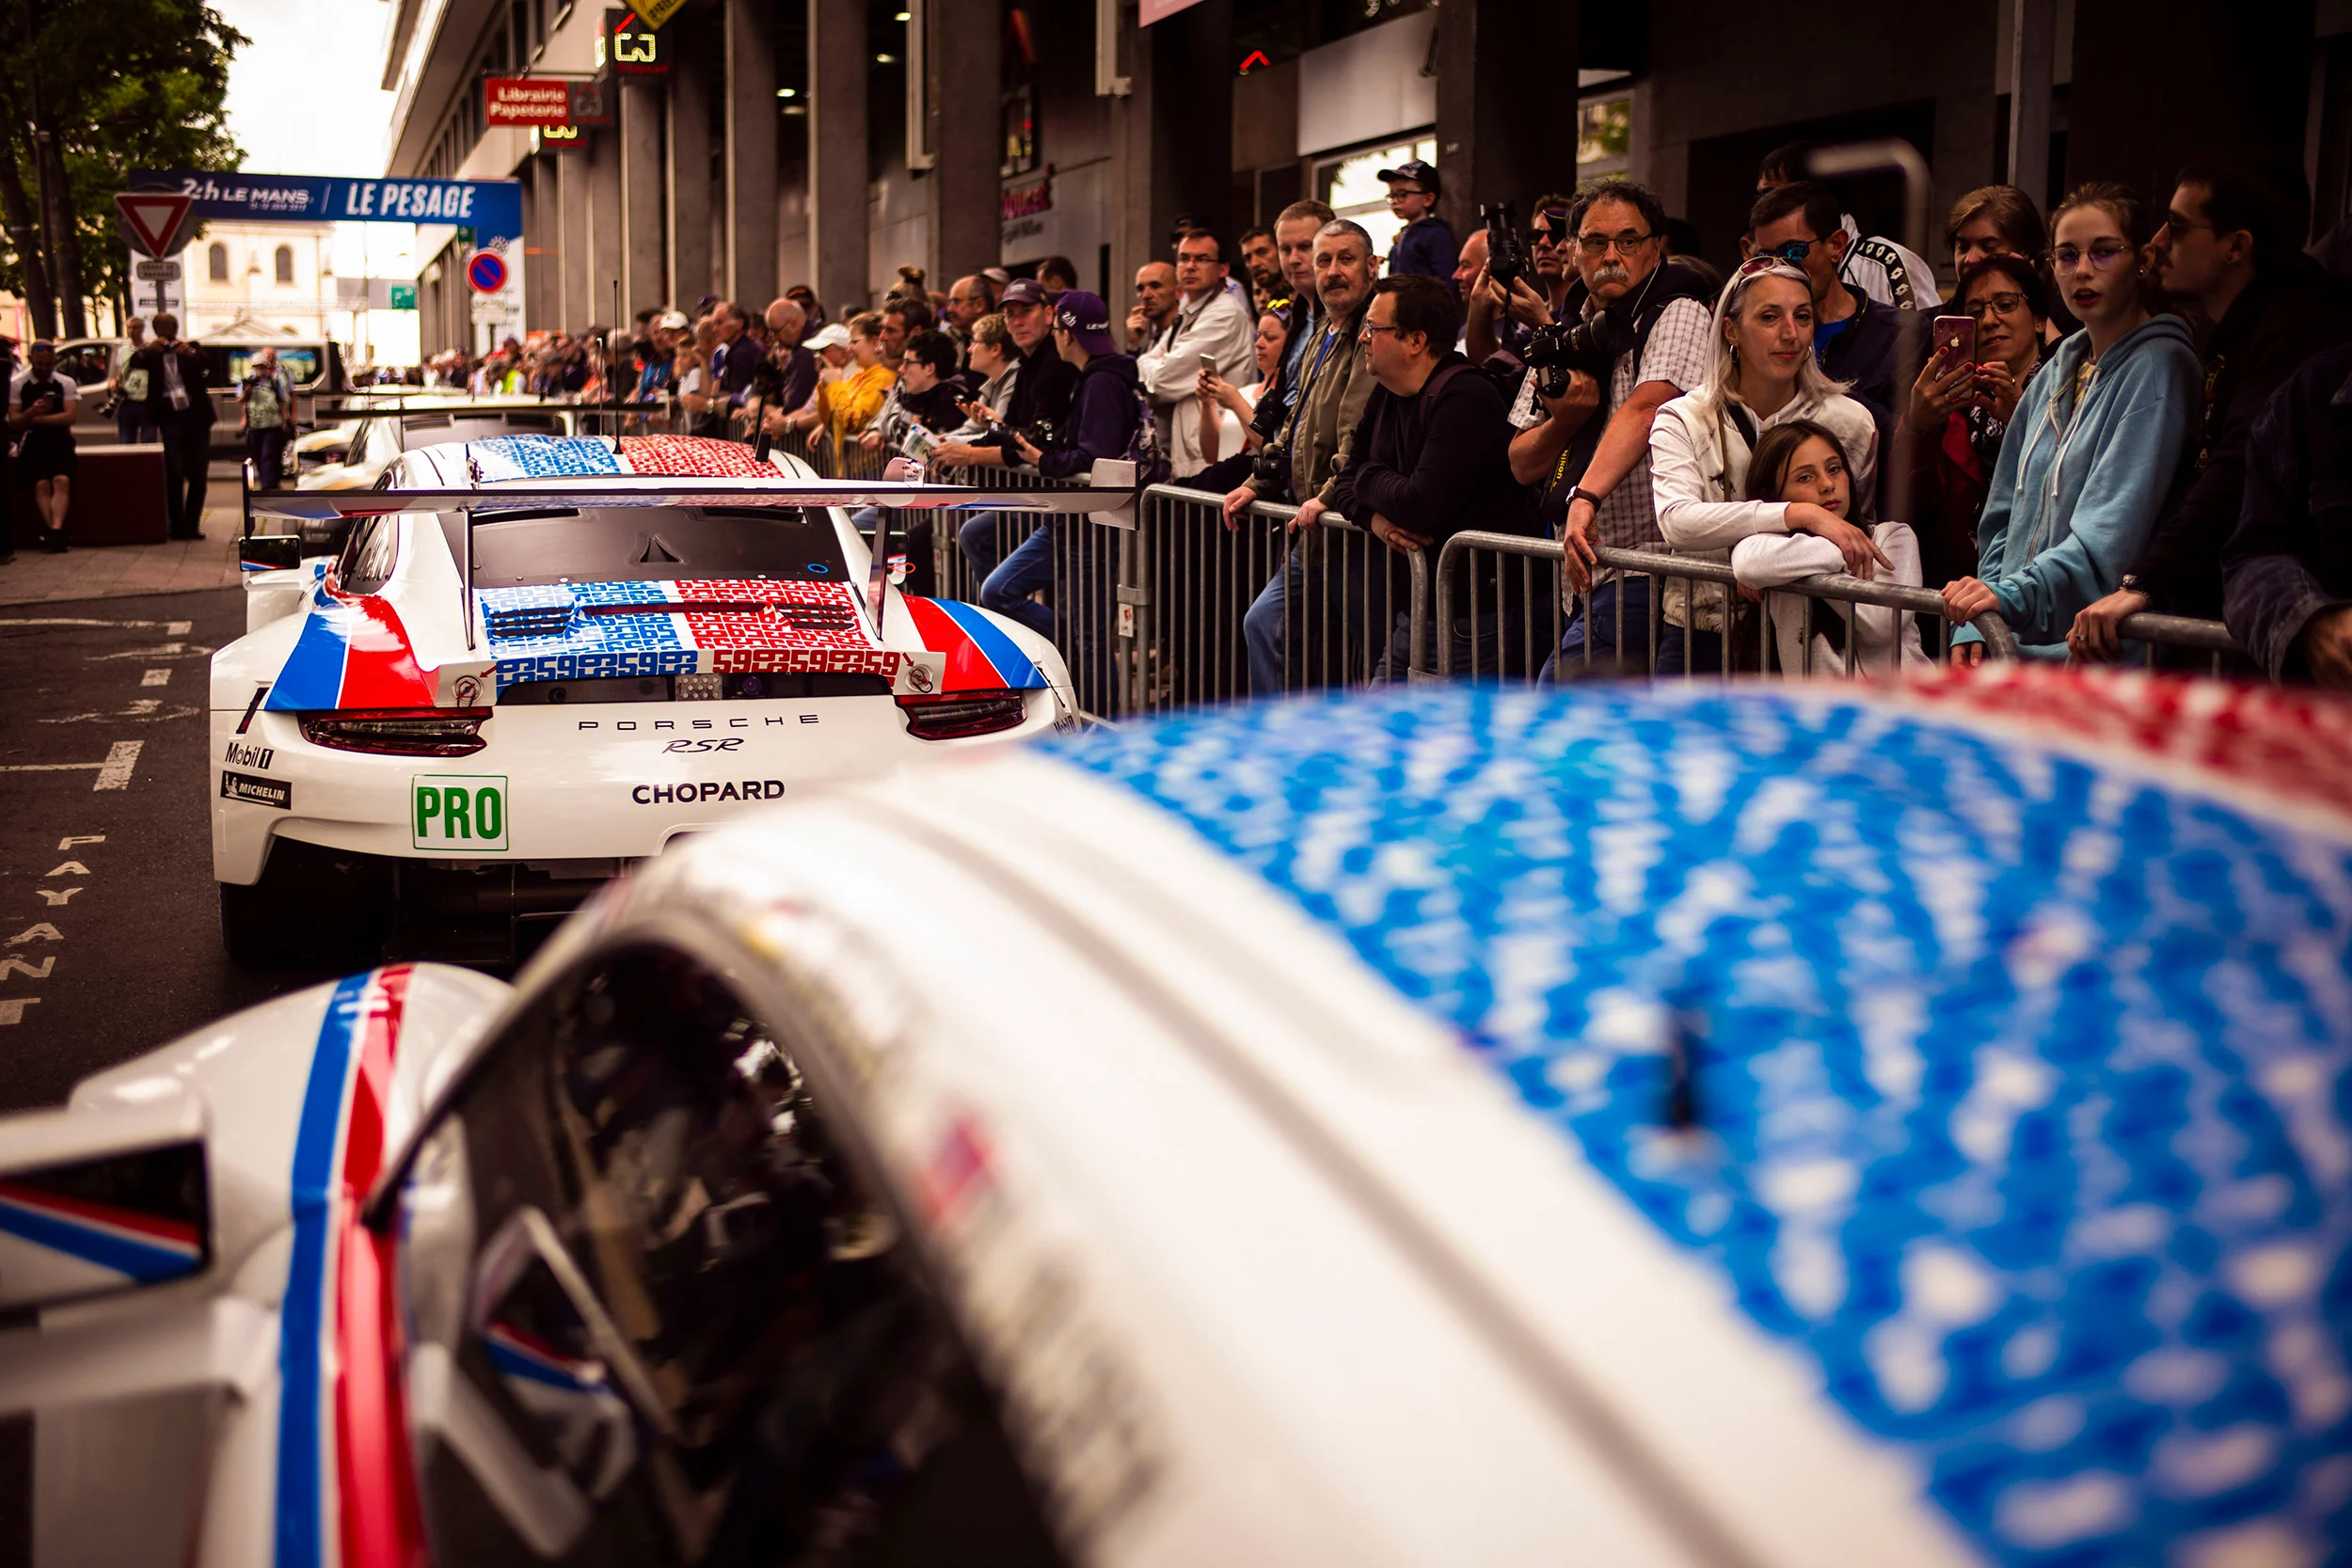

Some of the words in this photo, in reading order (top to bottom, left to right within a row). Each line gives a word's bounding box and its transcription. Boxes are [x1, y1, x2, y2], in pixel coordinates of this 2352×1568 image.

[497, 87, 566, 102] Librairie
[489, 101, 566, 119] Papeterie
[222, 188, 247, 201] LE
[249, 189, 310, 203] MANS
[345, 182, 376, 215] LE
[380, 183, 476, 218] PESAGE
[1556, 450, 1568, 480] Nikon
[536, 656, 577, 679] 59
[618, 652, 659, 675] 59
[712, 649, 752, 673] 59
[789, 650, 828, 673] 59
[863, 651, 900, 675] 59
[578, 714, 819, 731] PORSCHE
[225, 741, 261, 768] Mobil
[258, 748, 275, 769] 1
[661, 737, 745, 754] RSR
[238, 783, 285, 801] MICHELIN
[631, 780, 786, 805] CHOPARD
[417, 786, 502, 840] PRO
[0, 834, 106, 1025] PAYANT
